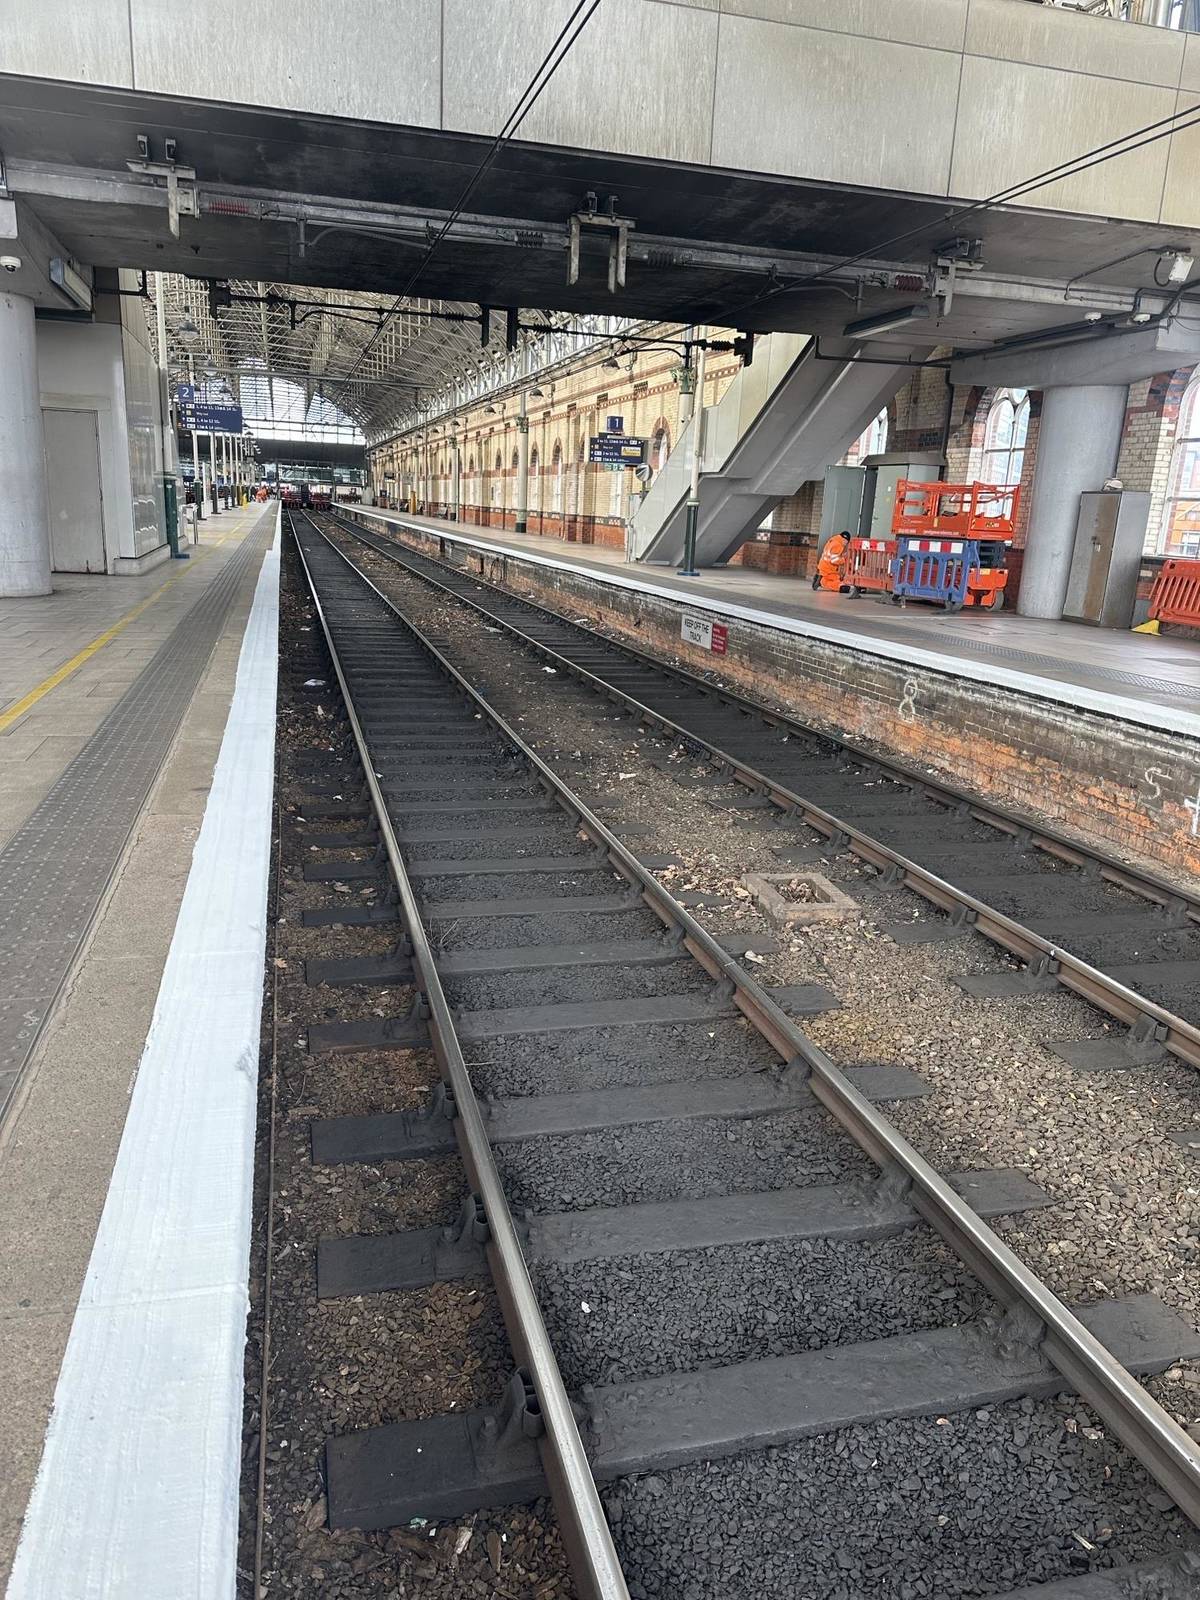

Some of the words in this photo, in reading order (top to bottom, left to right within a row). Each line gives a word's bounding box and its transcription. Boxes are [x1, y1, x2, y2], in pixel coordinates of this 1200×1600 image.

[182, 387, 190, 398] 2
[614, 418, 619, 428] 1
[684, 618, 694, 628] KEEP
[694, 620, 702, 631] OFF
[701, 623, 710, 634] THE
[689, 631, 702, 643] TRACK
